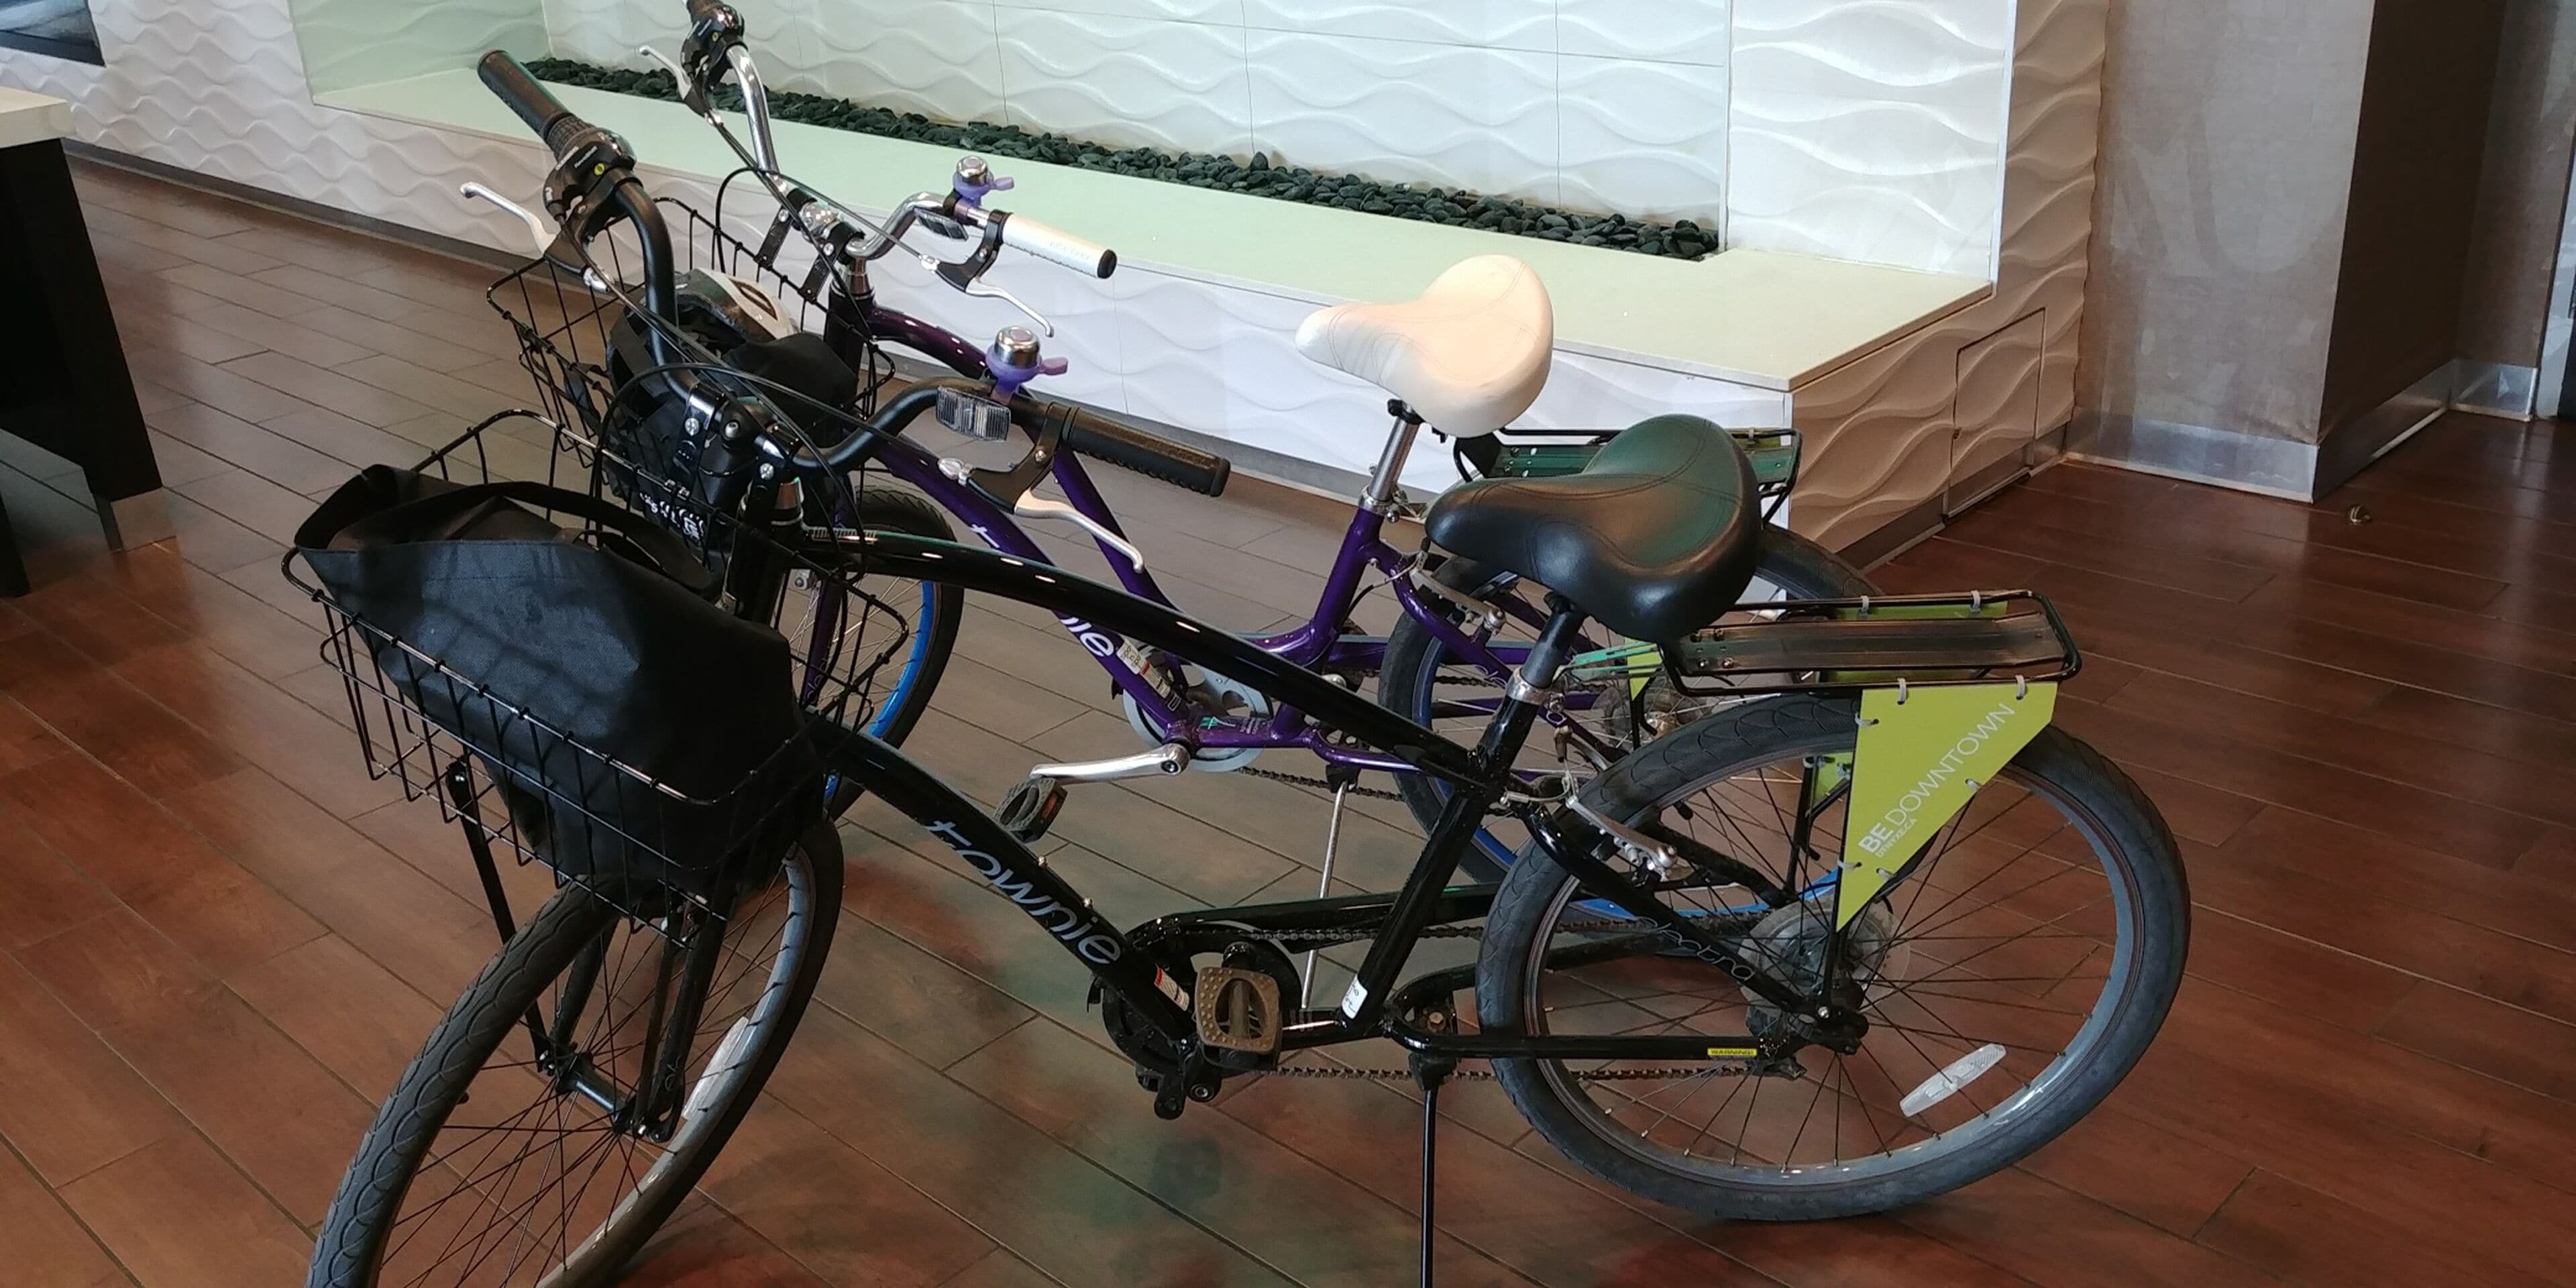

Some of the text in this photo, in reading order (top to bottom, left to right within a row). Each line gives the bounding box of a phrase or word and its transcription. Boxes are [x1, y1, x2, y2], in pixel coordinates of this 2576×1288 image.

[1858, 702, 2015, 853] BE DOWNTOWN
[925, 820, 1122, 965] townie
[1635, 916, 1756, 981] electra
